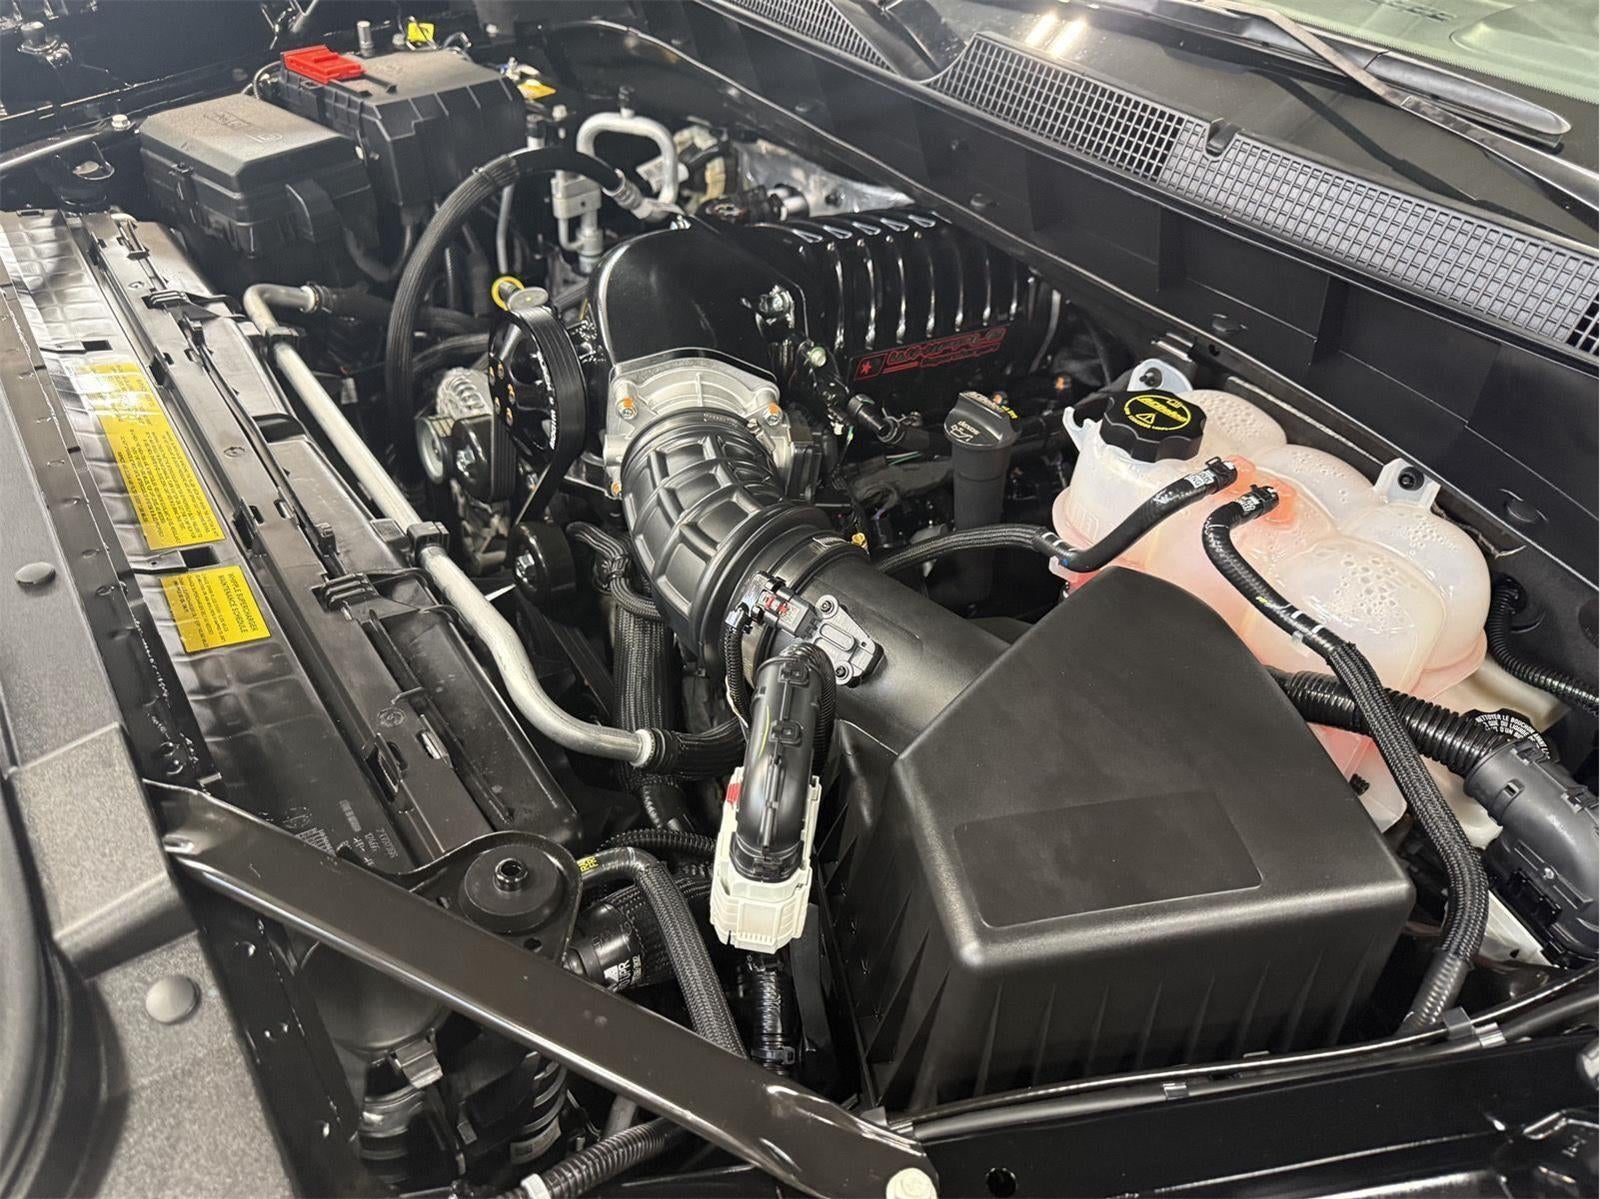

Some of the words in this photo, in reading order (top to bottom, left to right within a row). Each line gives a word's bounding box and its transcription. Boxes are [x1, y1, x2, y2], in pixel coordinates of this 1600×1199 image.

[549, 408, 557, 450] WIDOW
[1475, 713, 1501, 723] NETTOYER
[1510, 717, 1536, 734] BOUCHON
[1533, 732, 1547, 747] AVANT
[1509, 723, 1530, 737] LIQUIDE
